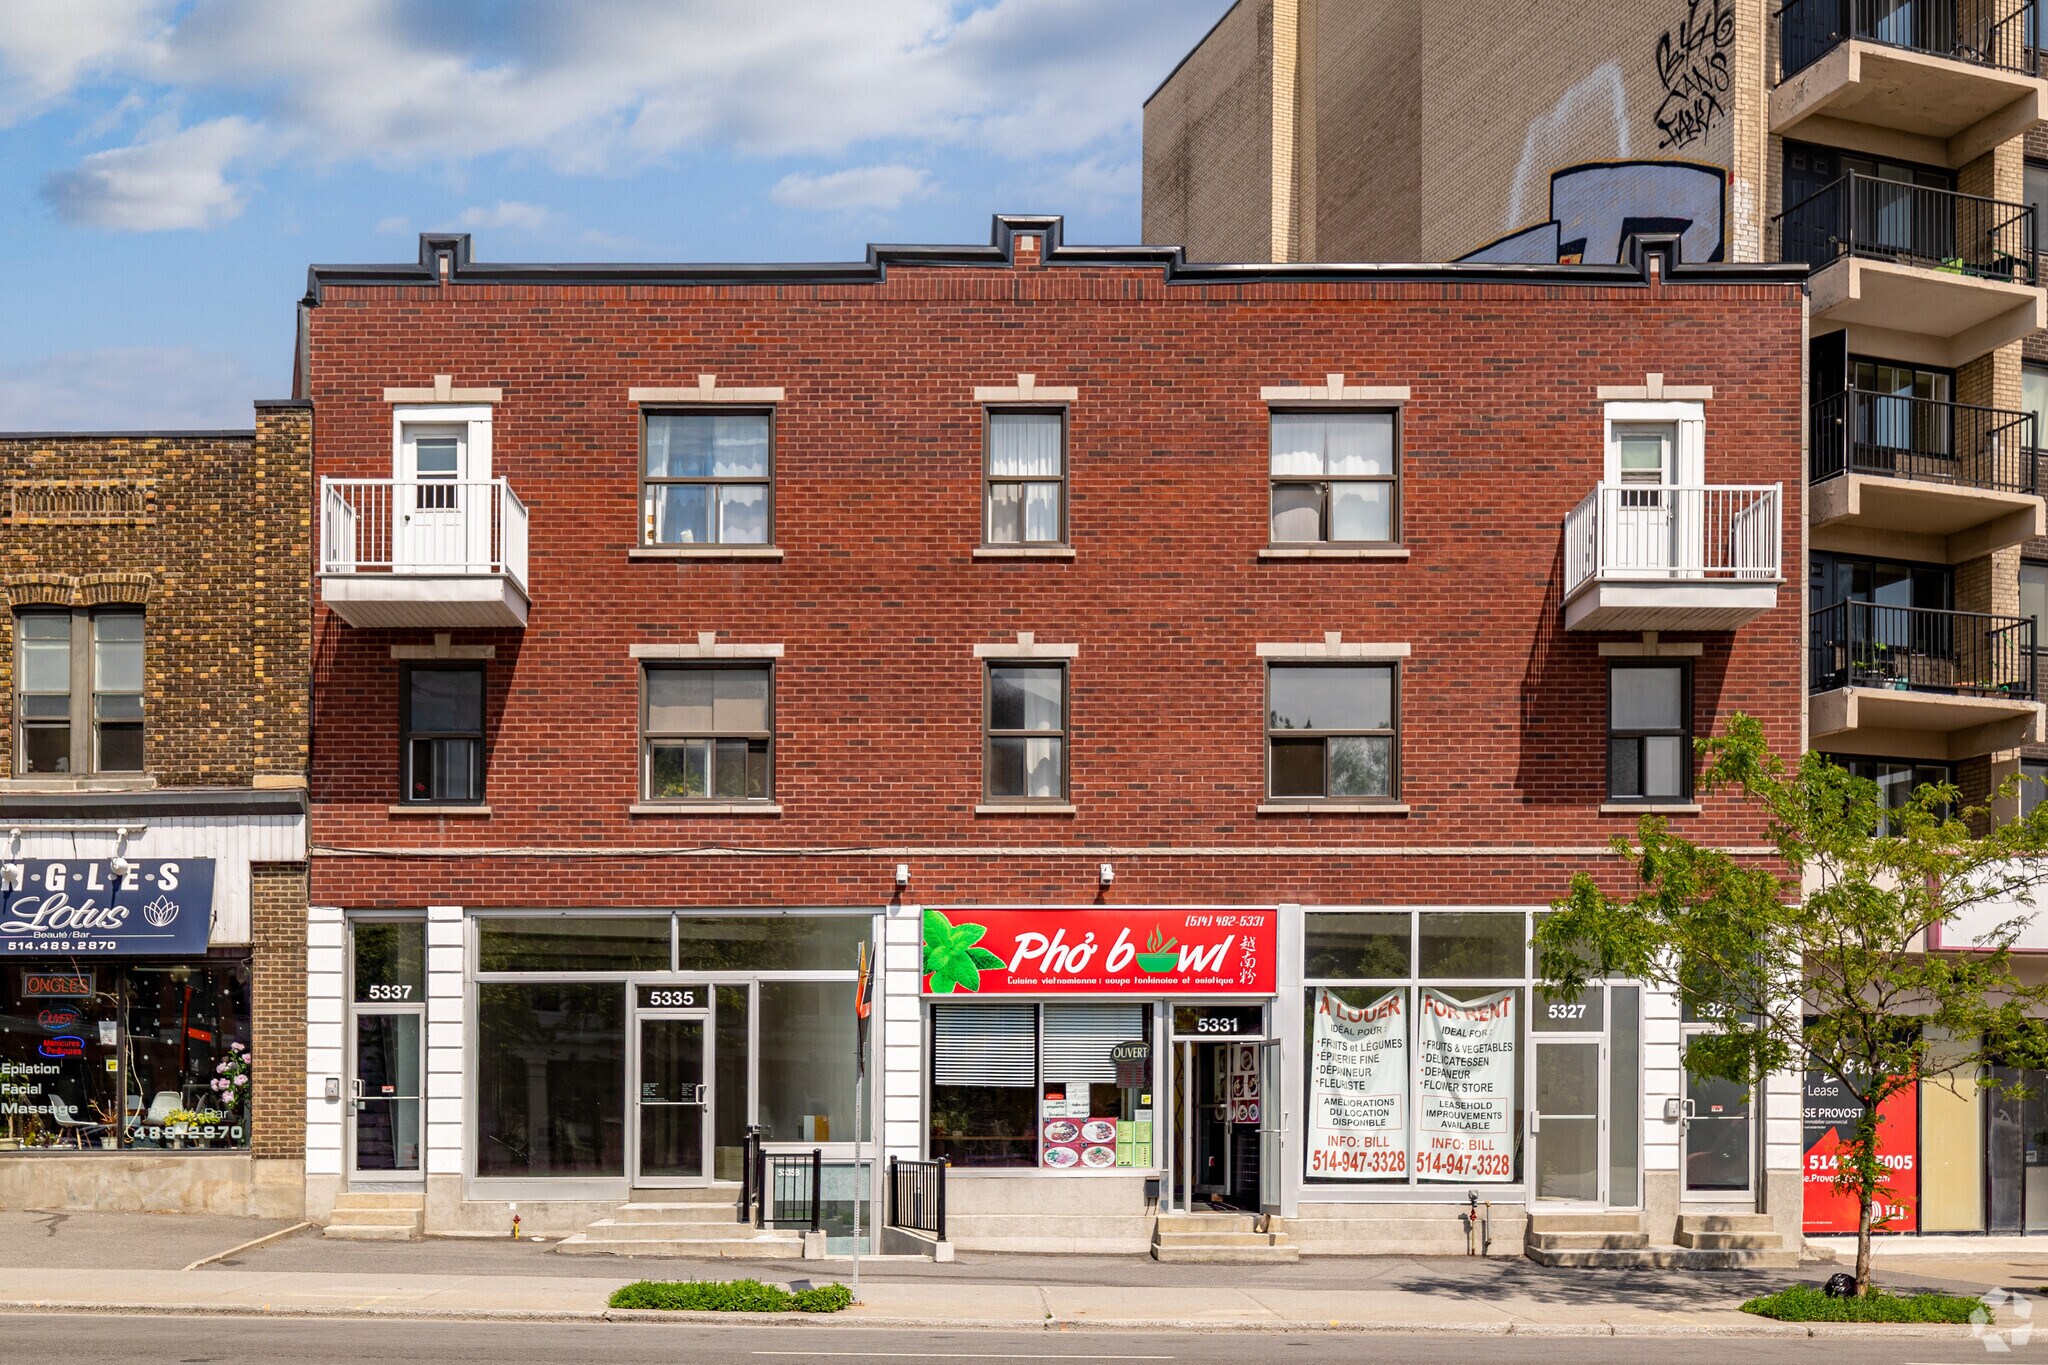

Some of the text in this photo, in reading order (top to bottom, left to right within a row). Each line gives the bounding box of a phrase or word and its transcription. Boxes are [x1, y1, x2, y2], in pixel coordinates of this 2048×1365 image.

[0, 892, 130, 933] Lotus
[1185, 915, 1264, 927] (514) 482-5331
[8, 941, 116, 950] 514.489.2870
[28, 977, 89, 993] ONGLES
[1007, 976, 1038, 985] Cuisine
[1041, 976, 1097, 985] vietnamienne
[1105, 978, 1131, 987] soupe
[1182, 976, 1190, 985] et
[369, 985, 412, 999] 5337
[650, 991, 694, 1006] 5335
[1319, 990, 1401, 1023] À LOUER
[1424, 994, 1512, 1022] FOR RENT
[1548, 1004, 1587, 1019] 5327
[1197, 1018, 1238, 1032] 5331
[1330, 1023, 1355, 1036] IDÉAL
[1357, 1026, 1383, 1036] POUR
[1441, 1026, 1467, 1038] IDEAL
[1468, 1029, 1488, 1038] FOR
[46, 1047, 82, 1055] Pedicures
[1350, 1044, 1358, 1052] et
[1360, 1038, 1403, 1052] LÉGUMES
[1426, 1040, 1513, 1054] FRUITS & VEGETABLES
[1113, 1046, 1148, 1059] OUVERT
[1359, 1053, 1380, 1064] FINE
[1425, 1053, 1490, 1067] DELICATESSEN
[1, 1063, 60, 1077] Epilation
[1320, 1063, 1372, 1077] DÉPANNEUR
[1424, 1066, 1471, 1079] DEPANEUR
[1, 1083, 42, 1095] Facial
[1319, 1078, 1365, 1090] FLEURISTE
[1423, 1080, 1494, 1093] FLOWER STORE
[1808, 1084, 1839, 1097] Lease
[1324, 1097, 1395, 1107] AMÉLIORATIONS
[1439, 1100, 1493, 1110] LEASEHOLD
[1, 1102, 79, 1116] Massage
[1329, 1108, 1389, 1117] DU LOCATION
[1818, 1108, 1863, 1118] PROVOST
[1332, 1118, 1386, 1127] DISPONIBLE
[1440, 1120, 1490, 1130] AVAILABLE
[1327, 1135, 1390, 1148] INFO: BILL
[1431, 1137, 1495, 1151] INFO: BILL
[1312, 1149, 1406, 1173] 514-947-3328
[1416, 1151, 1510, 1176] 514-947-3328
[1809, 1154, 1839, 1170] 514
